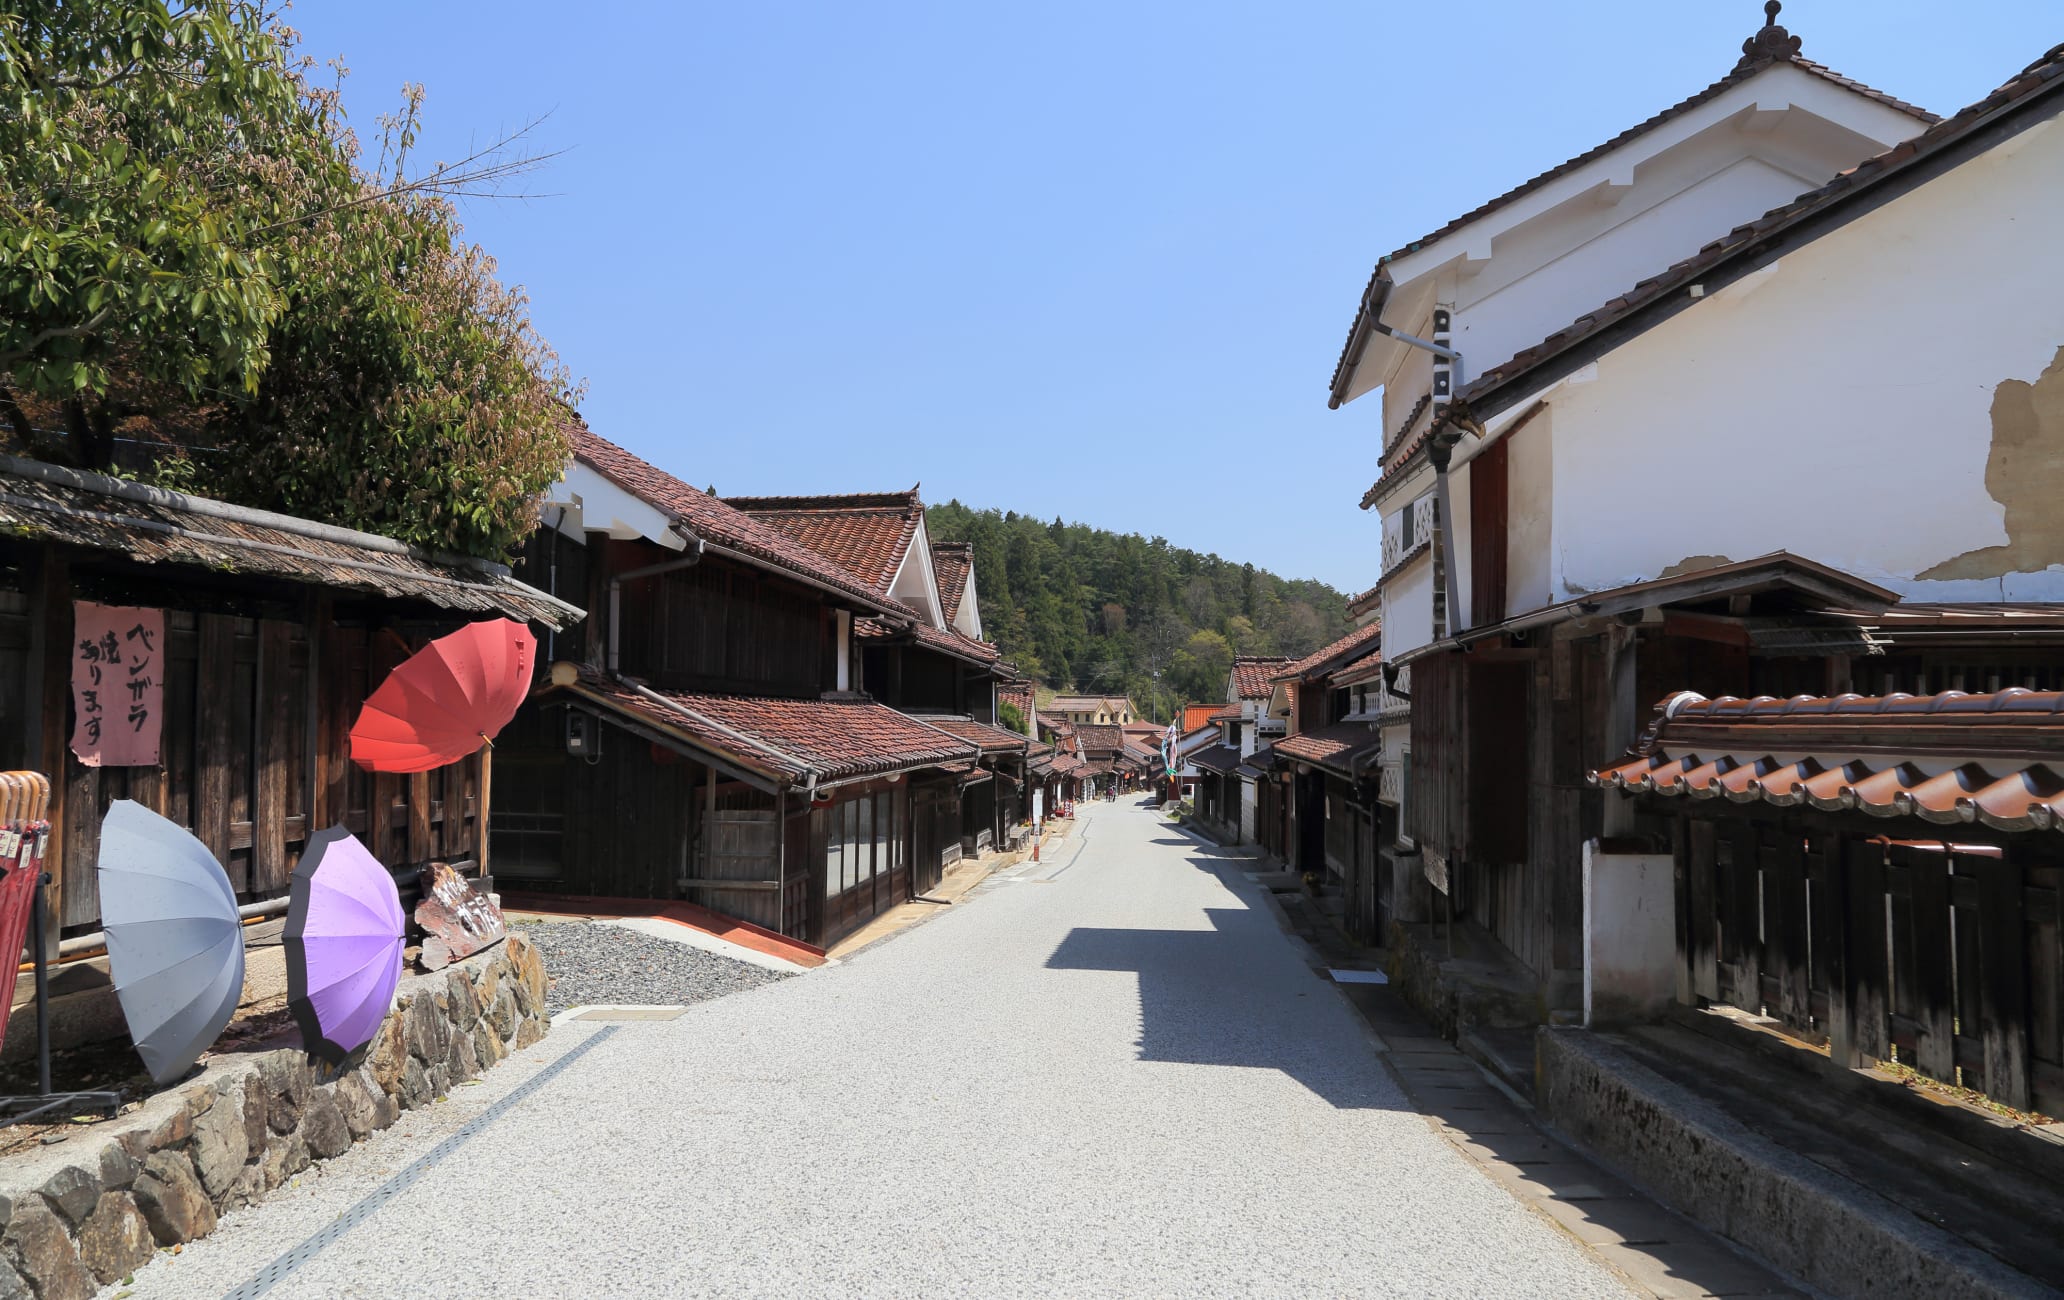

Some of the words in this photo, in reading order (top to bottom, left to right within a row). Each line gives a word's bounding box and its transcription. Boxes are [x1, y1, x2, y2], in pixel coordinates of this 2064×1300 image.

[79, 639, 102, 746] あります
[126, 623, 154, 733] ベンガラ
